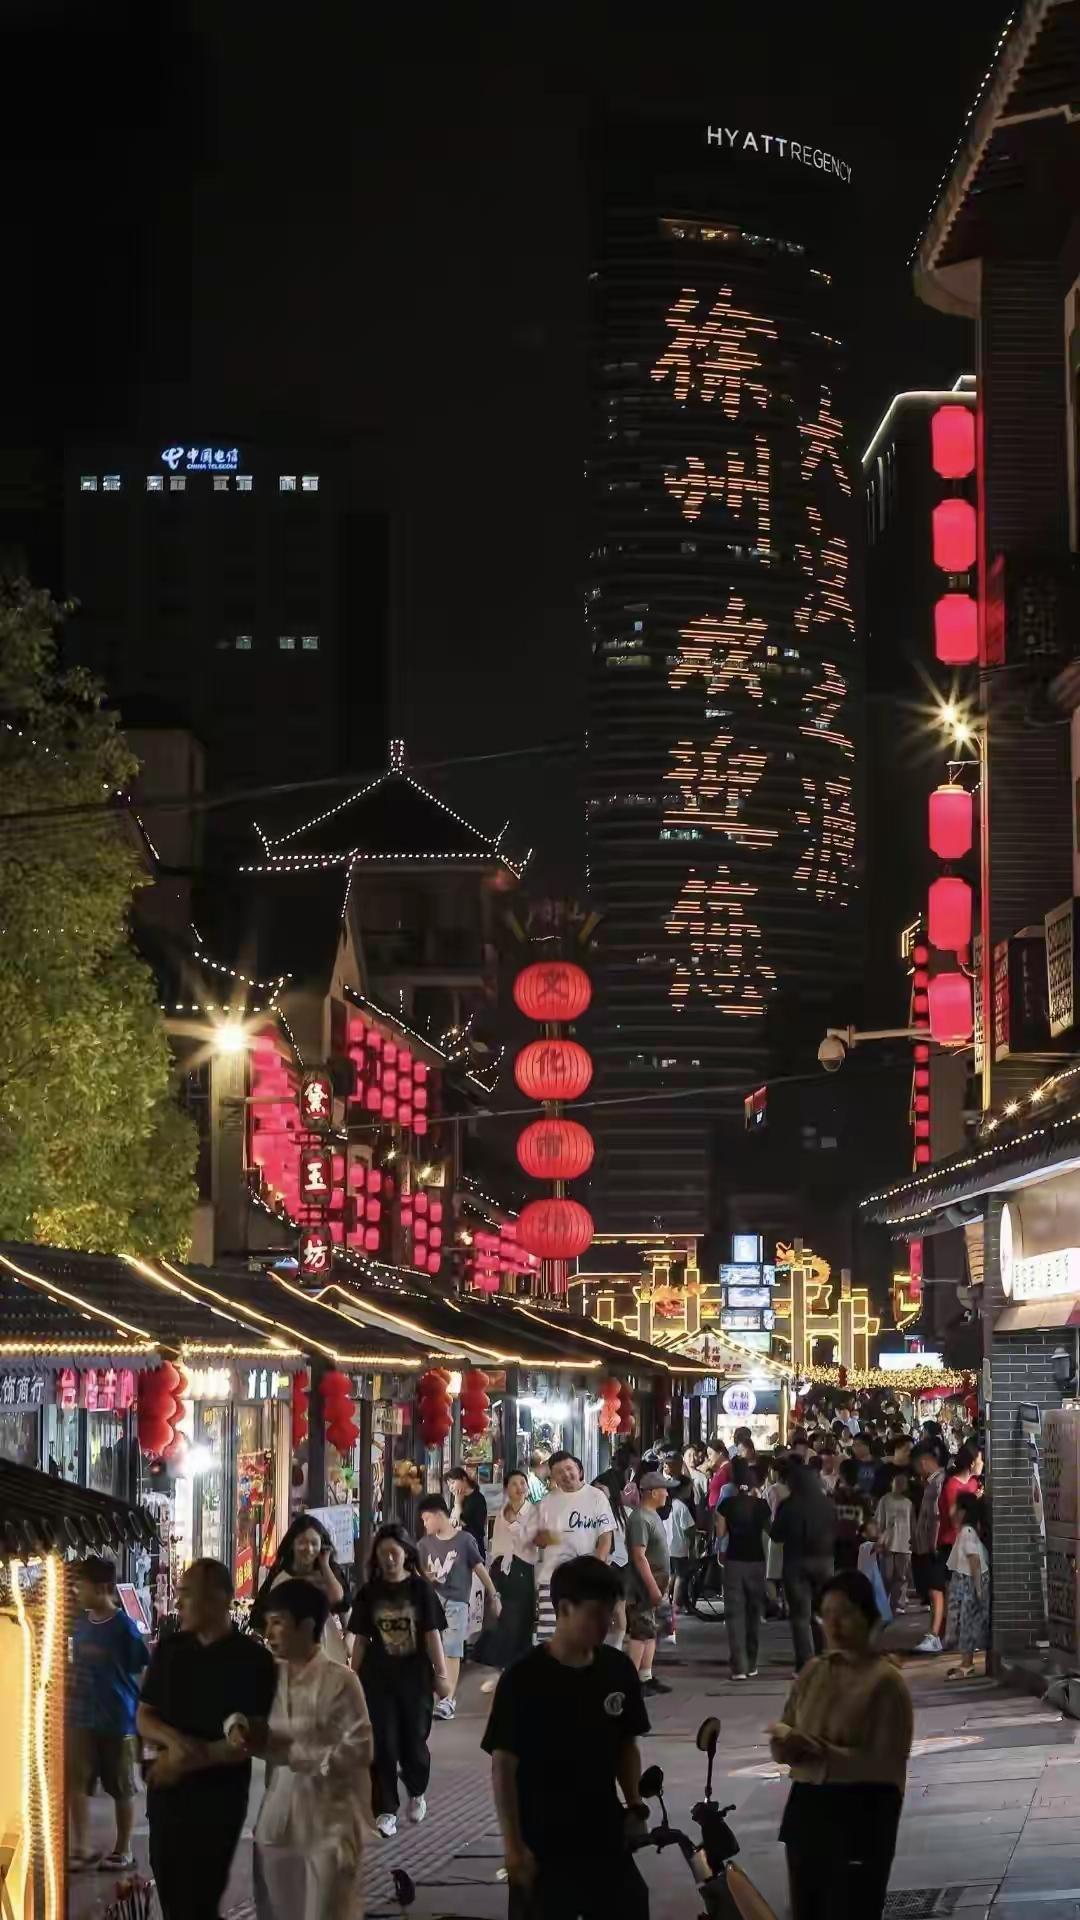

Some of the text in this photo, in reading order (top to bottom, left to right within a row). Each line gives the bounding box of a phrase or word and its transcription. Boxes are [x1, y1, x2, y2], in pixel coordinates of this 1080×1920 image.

[706, 125, 852, 183] HYATT REGENCY
[186, 447, 239, 464] 中国电信
